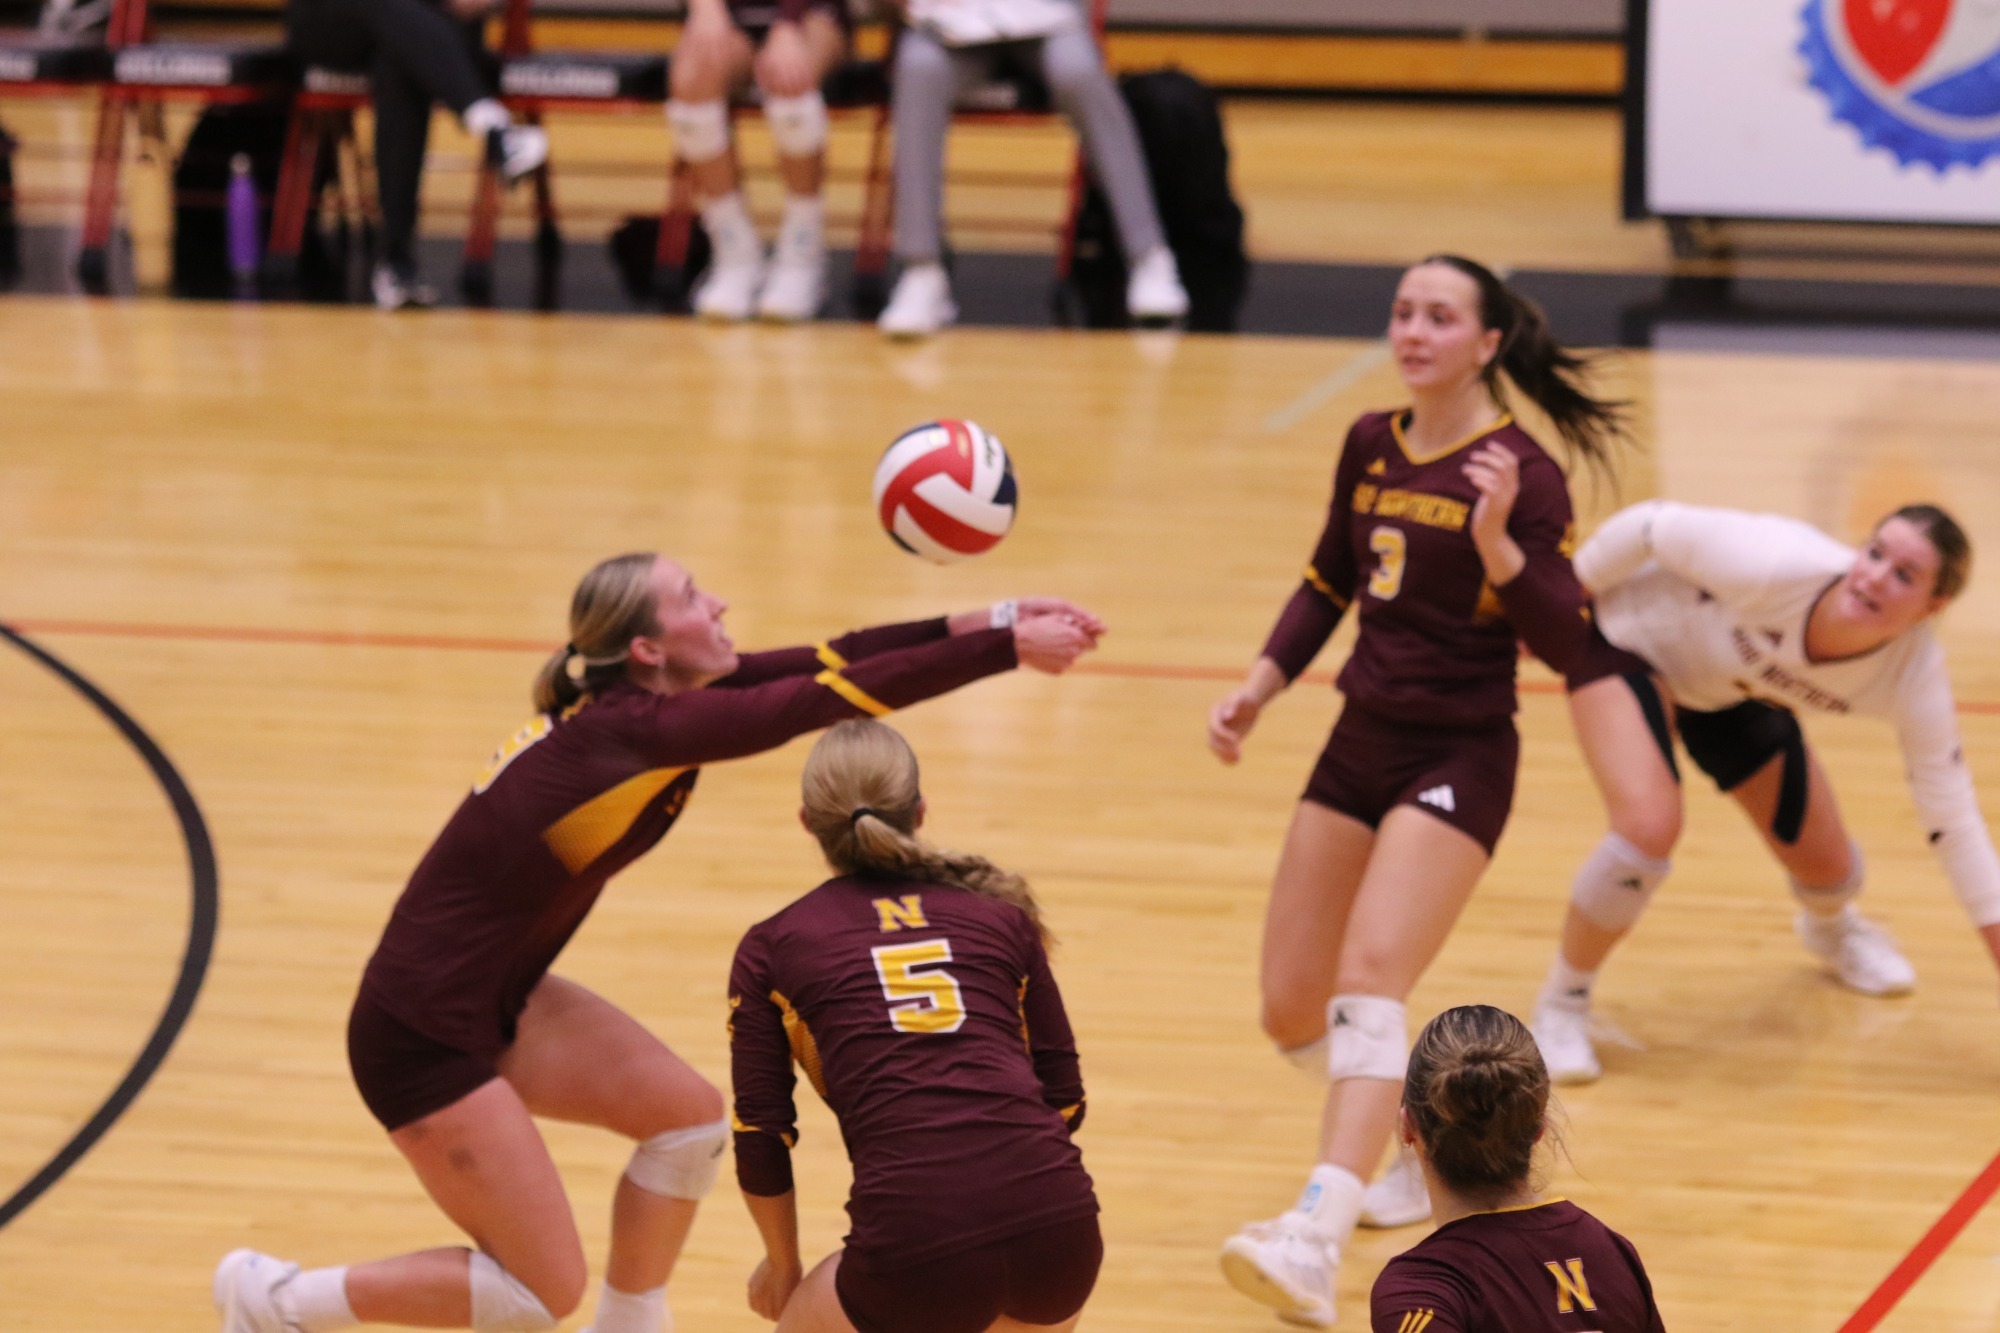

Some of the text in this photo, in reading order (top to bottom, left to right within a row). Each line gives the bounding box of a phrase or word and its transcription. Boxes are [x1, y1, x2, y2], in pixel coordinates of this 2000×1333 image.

[1368, 525, 1407, 600] 3
[871, 894, 930, 933] N
[870, 937, 968, 1033] 5
[1544, 1257, 1597, 1313] N
